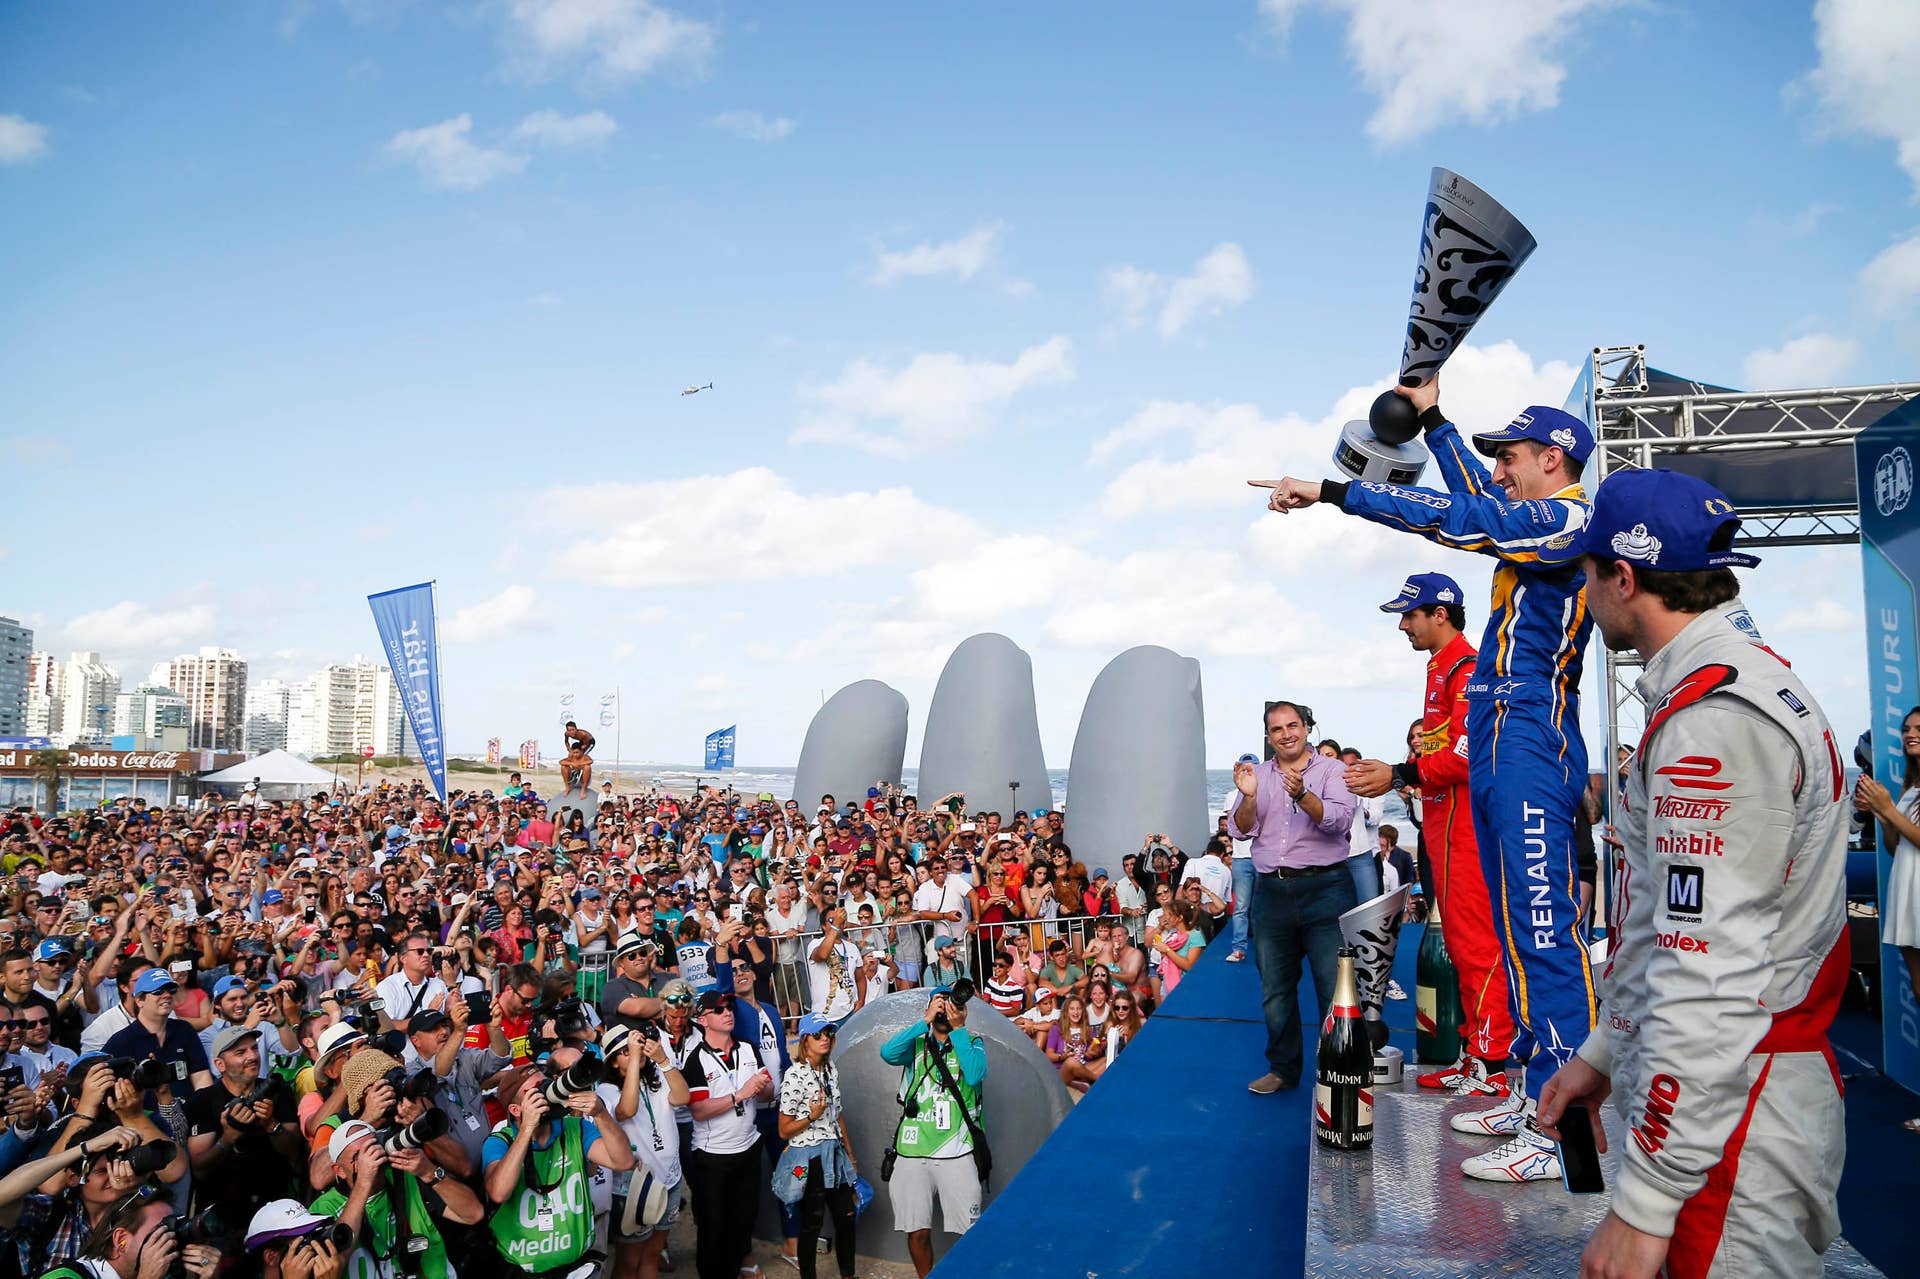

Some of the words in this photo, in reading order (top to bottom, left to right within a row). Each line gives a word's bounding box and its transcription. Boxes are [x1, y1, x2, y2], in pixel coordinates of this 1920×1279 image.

[1876, 460, 1909, 506] FIA
[1881, 607, 1904, 785] FUTURE
[68, 752, 118, 767] Dedos
[1653, 795, 1731, 821] VARIETY
[1656, 830, 1725, 856] mixbit
[1523, 801, 1557, 949] RENAULT
[1670, 873, 1699, 907] M
[680, 947, 704, 961] 533
[687, 963, 705, 973] HOST
[904, 1129, 917, 1141] 03
[520, 1172, 584, 1229] 040
[508, 1232, 572, 1257] Media
